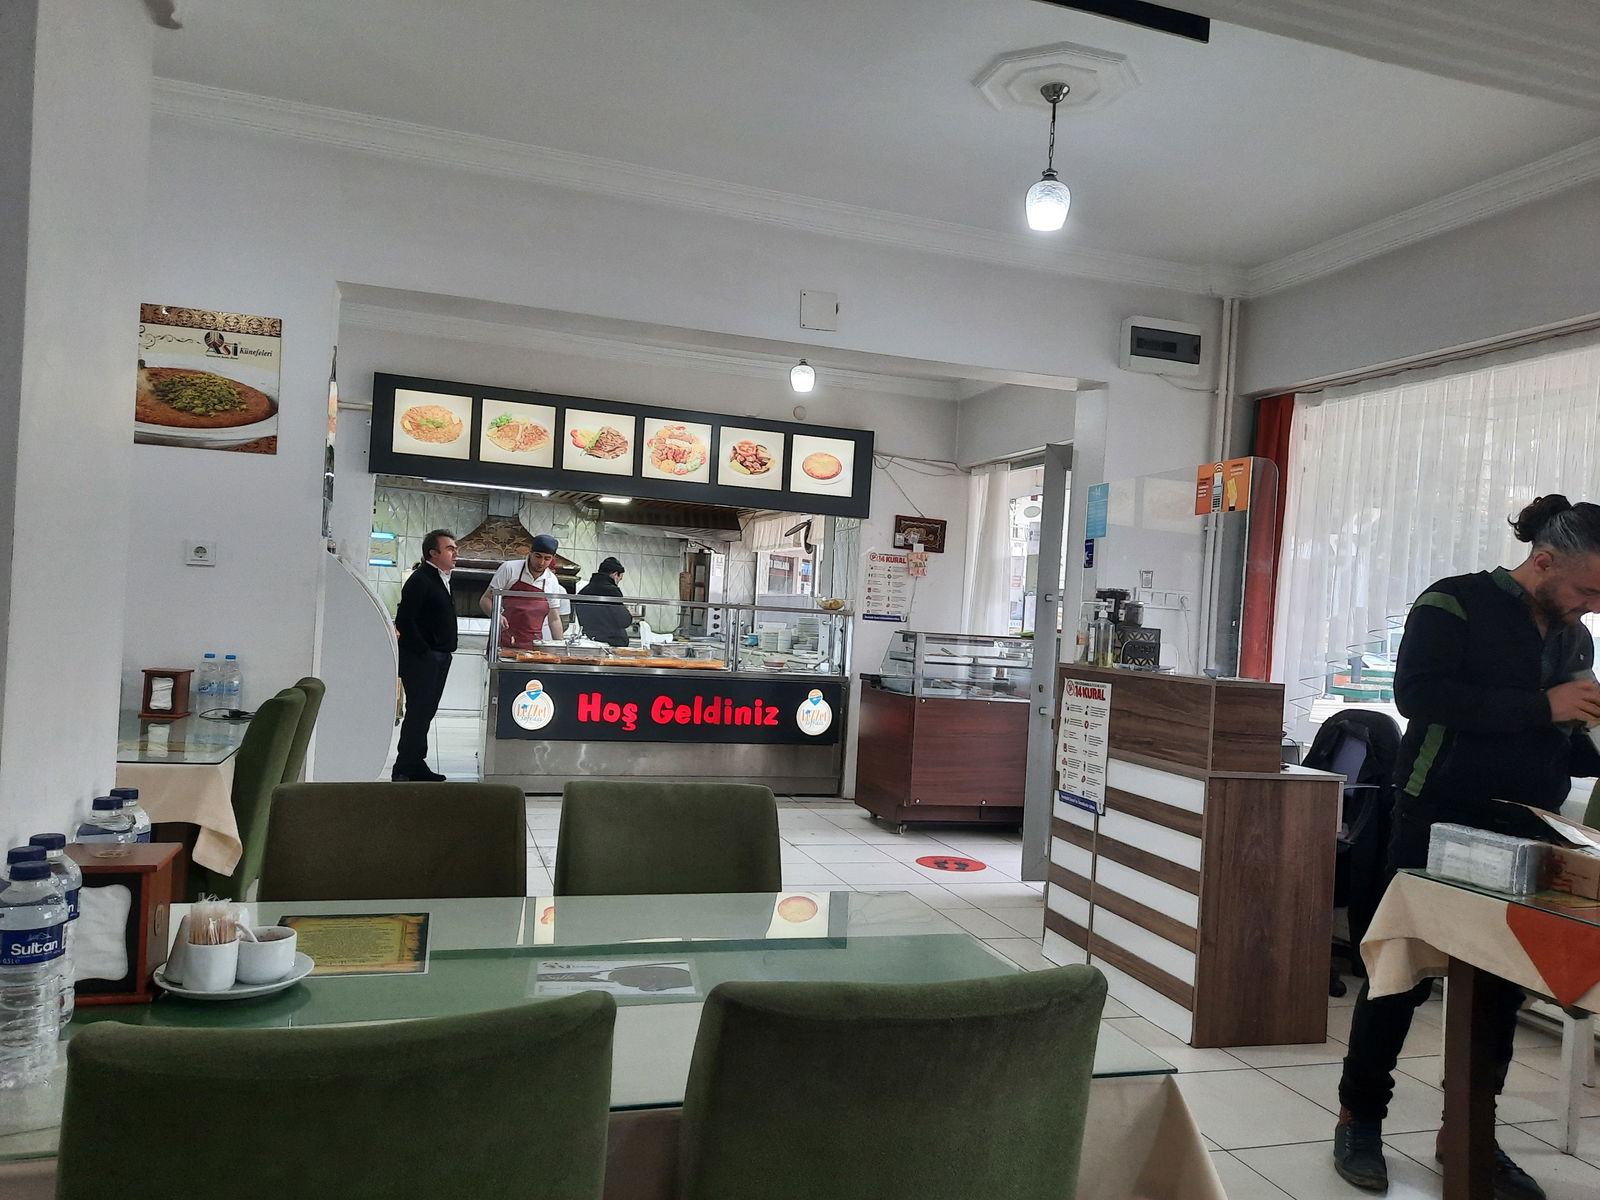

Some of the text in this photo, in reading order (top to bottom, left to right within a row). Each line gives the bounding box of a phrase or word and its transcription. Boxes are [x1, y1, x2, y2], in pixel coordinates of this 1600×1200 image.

[240, 348, 273, 357] Künefeleri
[1075, 685, 1106, 701] 14 KURAL
[577, 692, 780, 731] Hoş Geldiniz
[11, 941, 57, 955] Sultan
